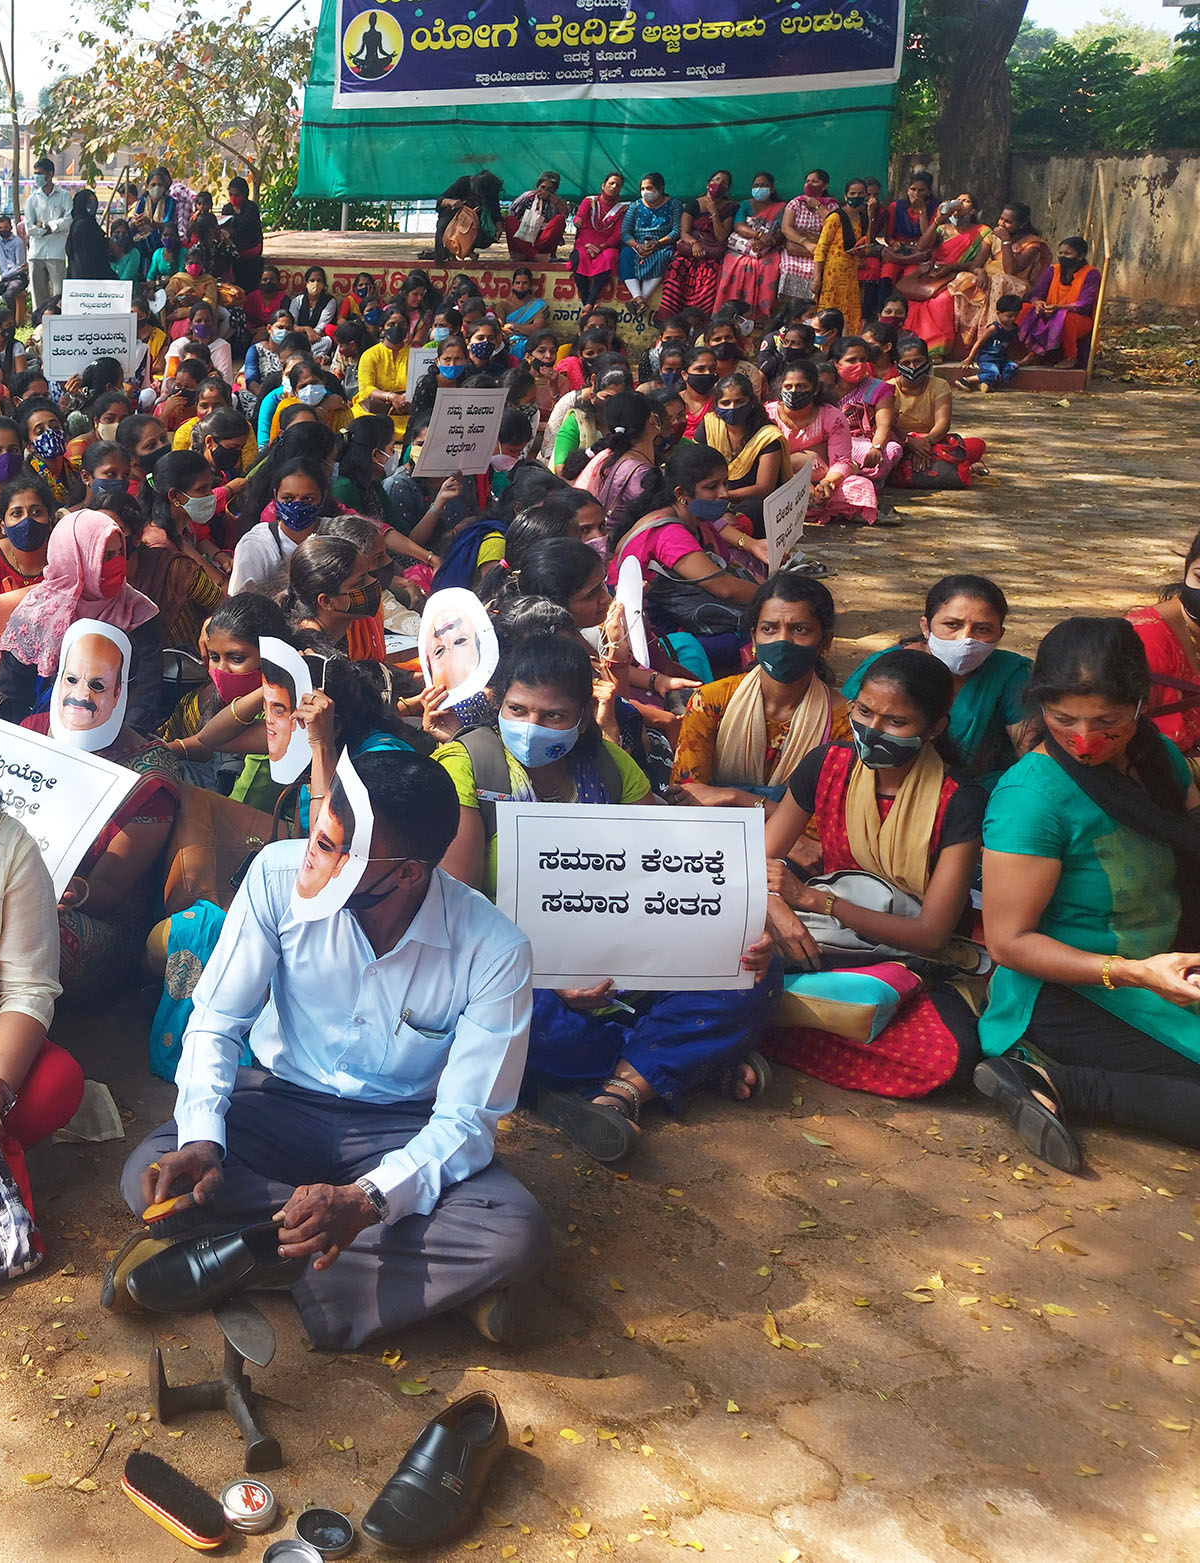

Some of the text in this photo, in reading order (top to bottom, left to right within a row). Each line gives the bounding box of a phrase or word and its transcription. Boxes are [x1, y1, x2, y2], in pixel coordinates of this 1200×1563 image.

[410, 9, 864, 53] ಯೋಗ ವೇದಿಕೆ ಅಜ್ಜರಕಾಡು ಉಡುಪಿ
[563, 49, 637, 66] ಇದಕ್ಕೆ ಕೊಡುಗೆ
[630, 66, 666, 77] ಉಡುಪಿ
[686, 62, 726, 79] ಬನ್ನಂಜೆ
[446, 404, 495, 420] ನಮ್ಮ ಹೋರಾಟ
[448, 423, 485, 439] ನಮ್ಮ ಸೇವಾ
[538, 846, 726, 886] ಸಮಾನ ಕೆಲಸಕ್ಕೆ
[541, 888, 722, 916] ಸಮಾನ ವೇತನ
